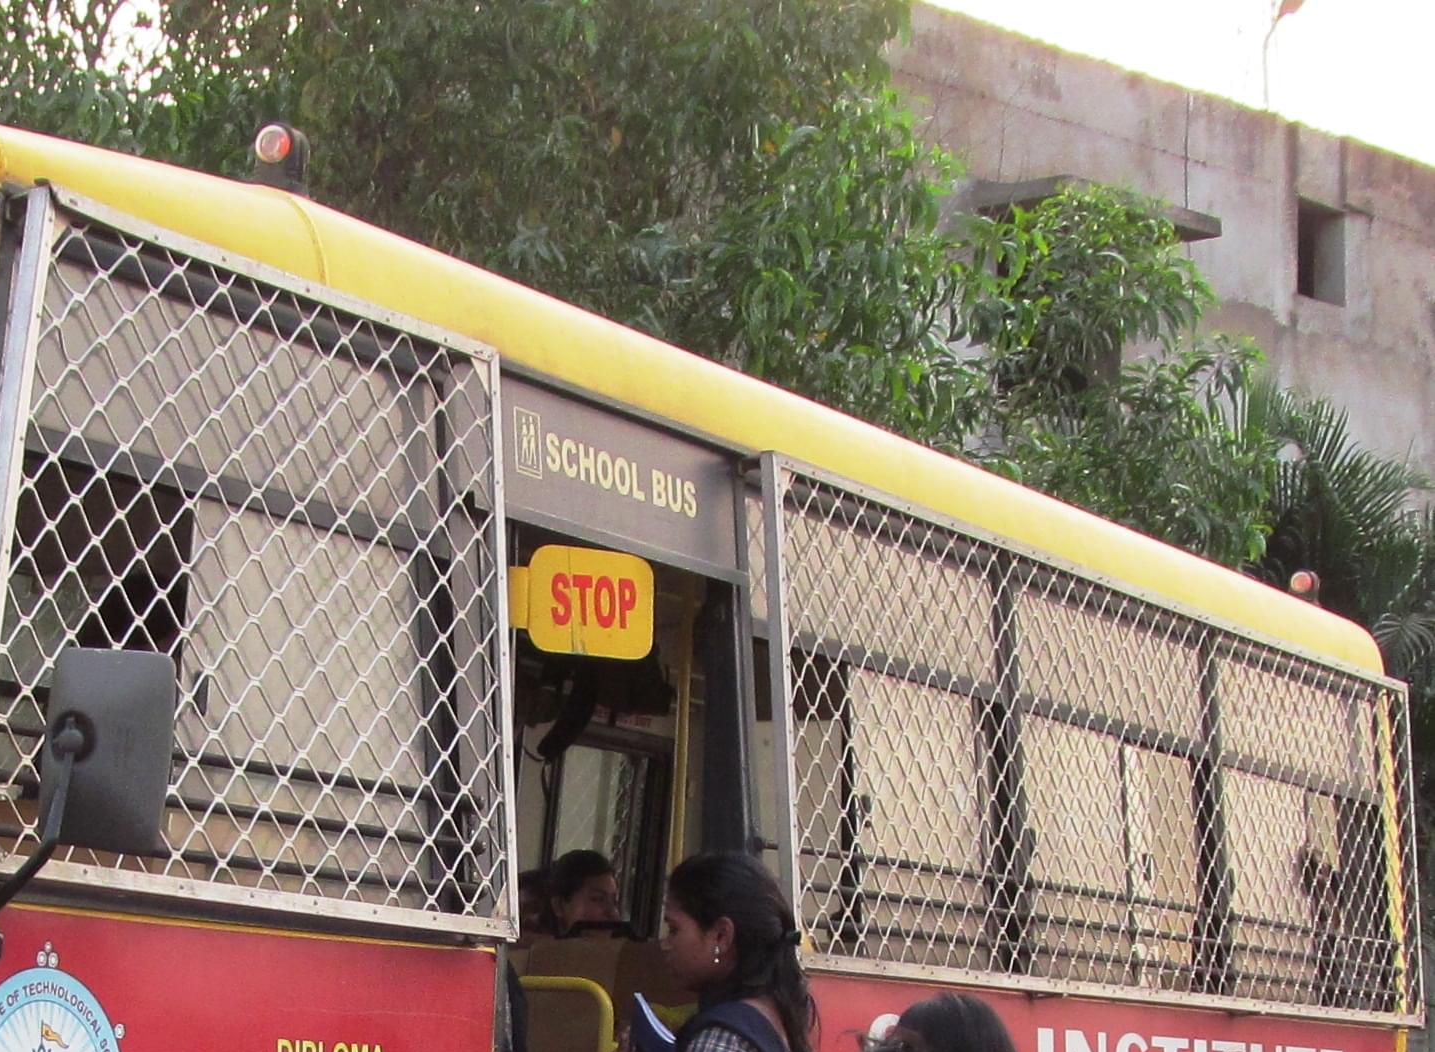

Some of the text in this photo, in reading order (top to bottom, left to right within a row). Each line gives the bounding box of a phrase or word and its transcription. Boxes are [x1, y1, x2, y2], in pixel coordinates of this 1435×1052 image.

[546, 432, 697, 518] SCHOOL BUS
[550, 572, 637, 629] STOP
[6, 989, 20, 1007] OF
[22, 981, 102, 1038] TECHNOLOGICAL
